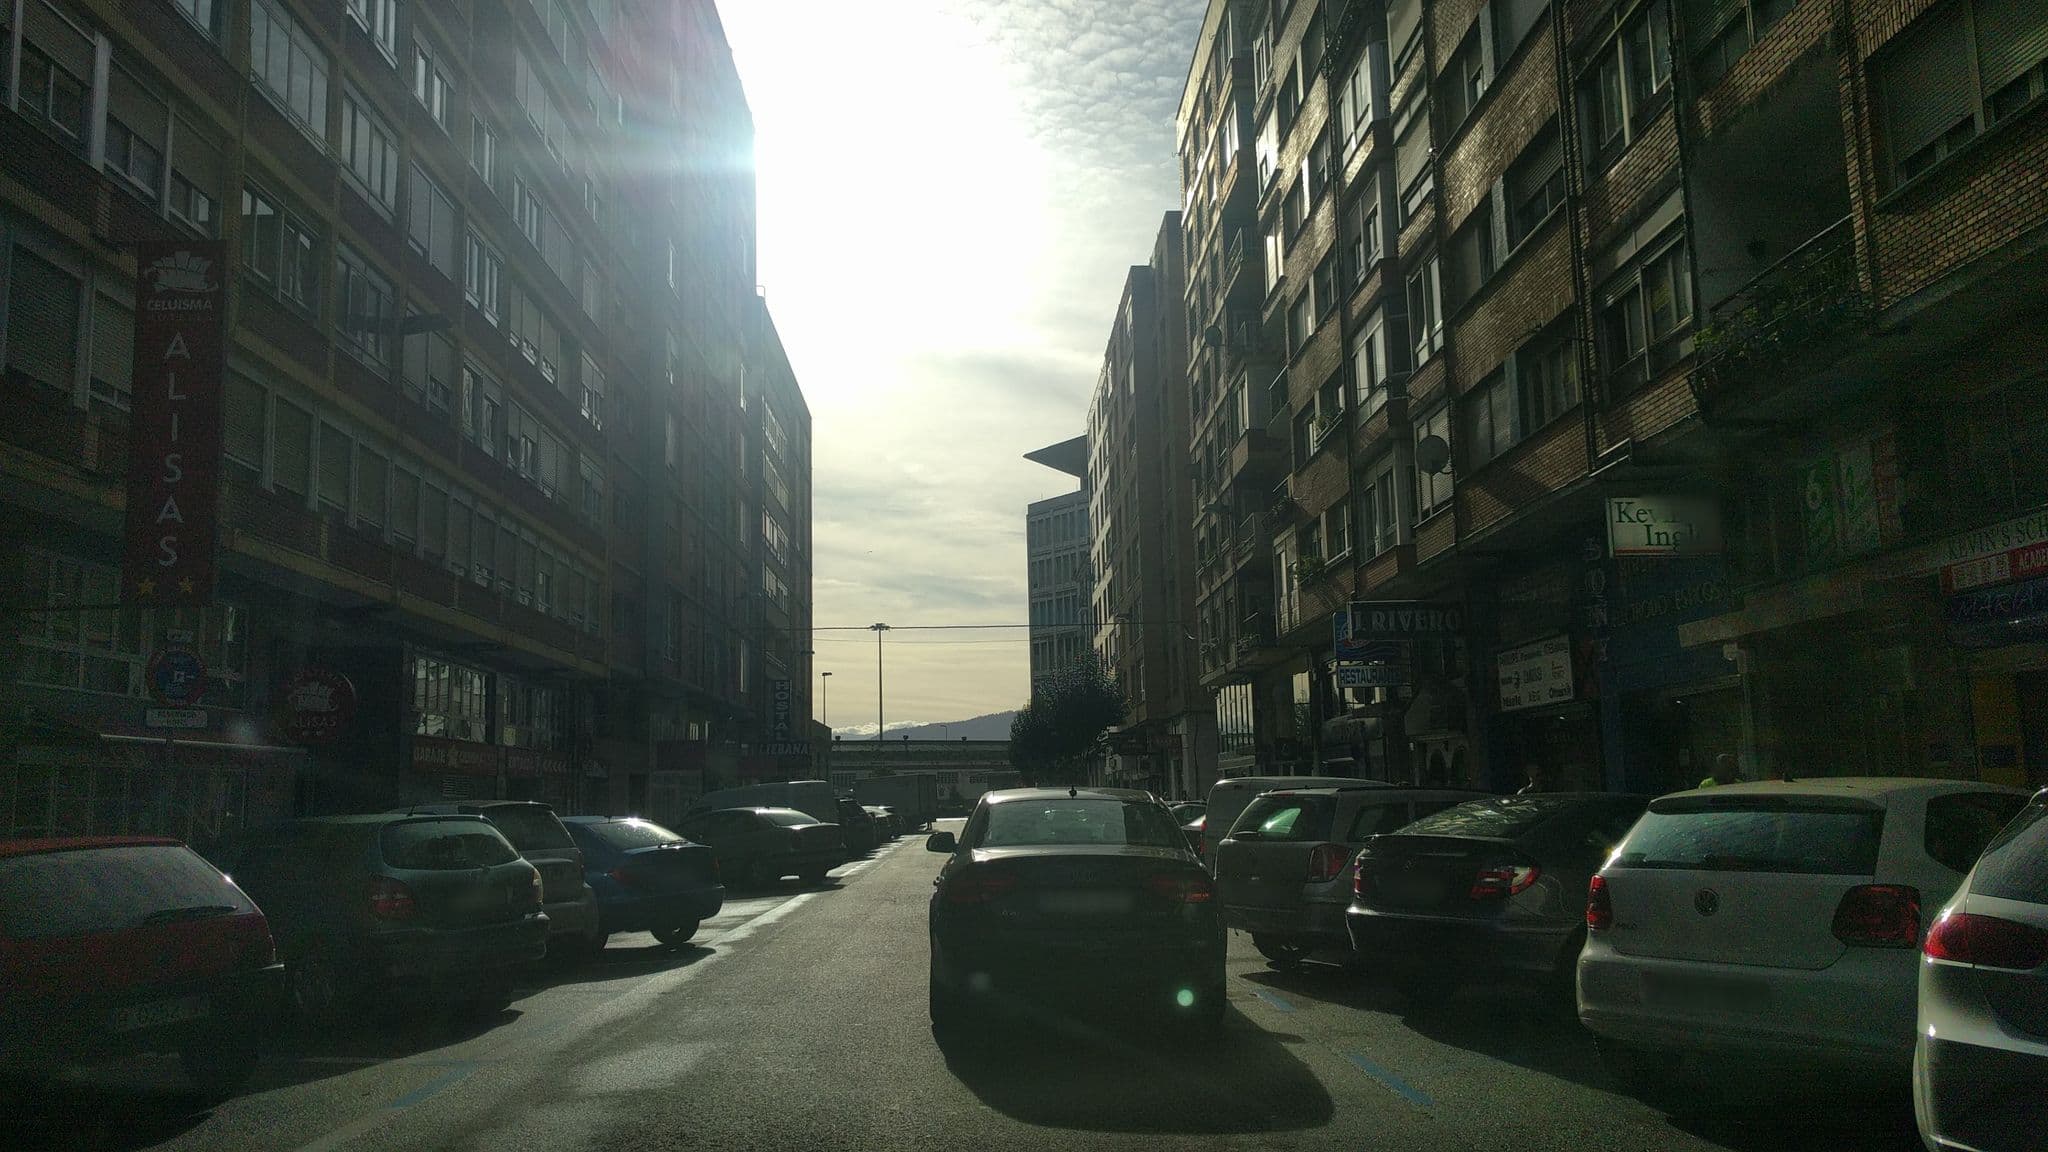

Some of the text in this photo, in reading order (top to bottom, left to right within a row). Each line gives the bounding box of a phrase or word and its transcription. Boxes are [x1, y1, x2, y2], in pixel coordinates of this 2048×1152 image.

[146, 299, 213, 311] CELUISMA
[157, 330, 191, 569] ALISAS
[774, 681, 790, 742] HOSTAL
